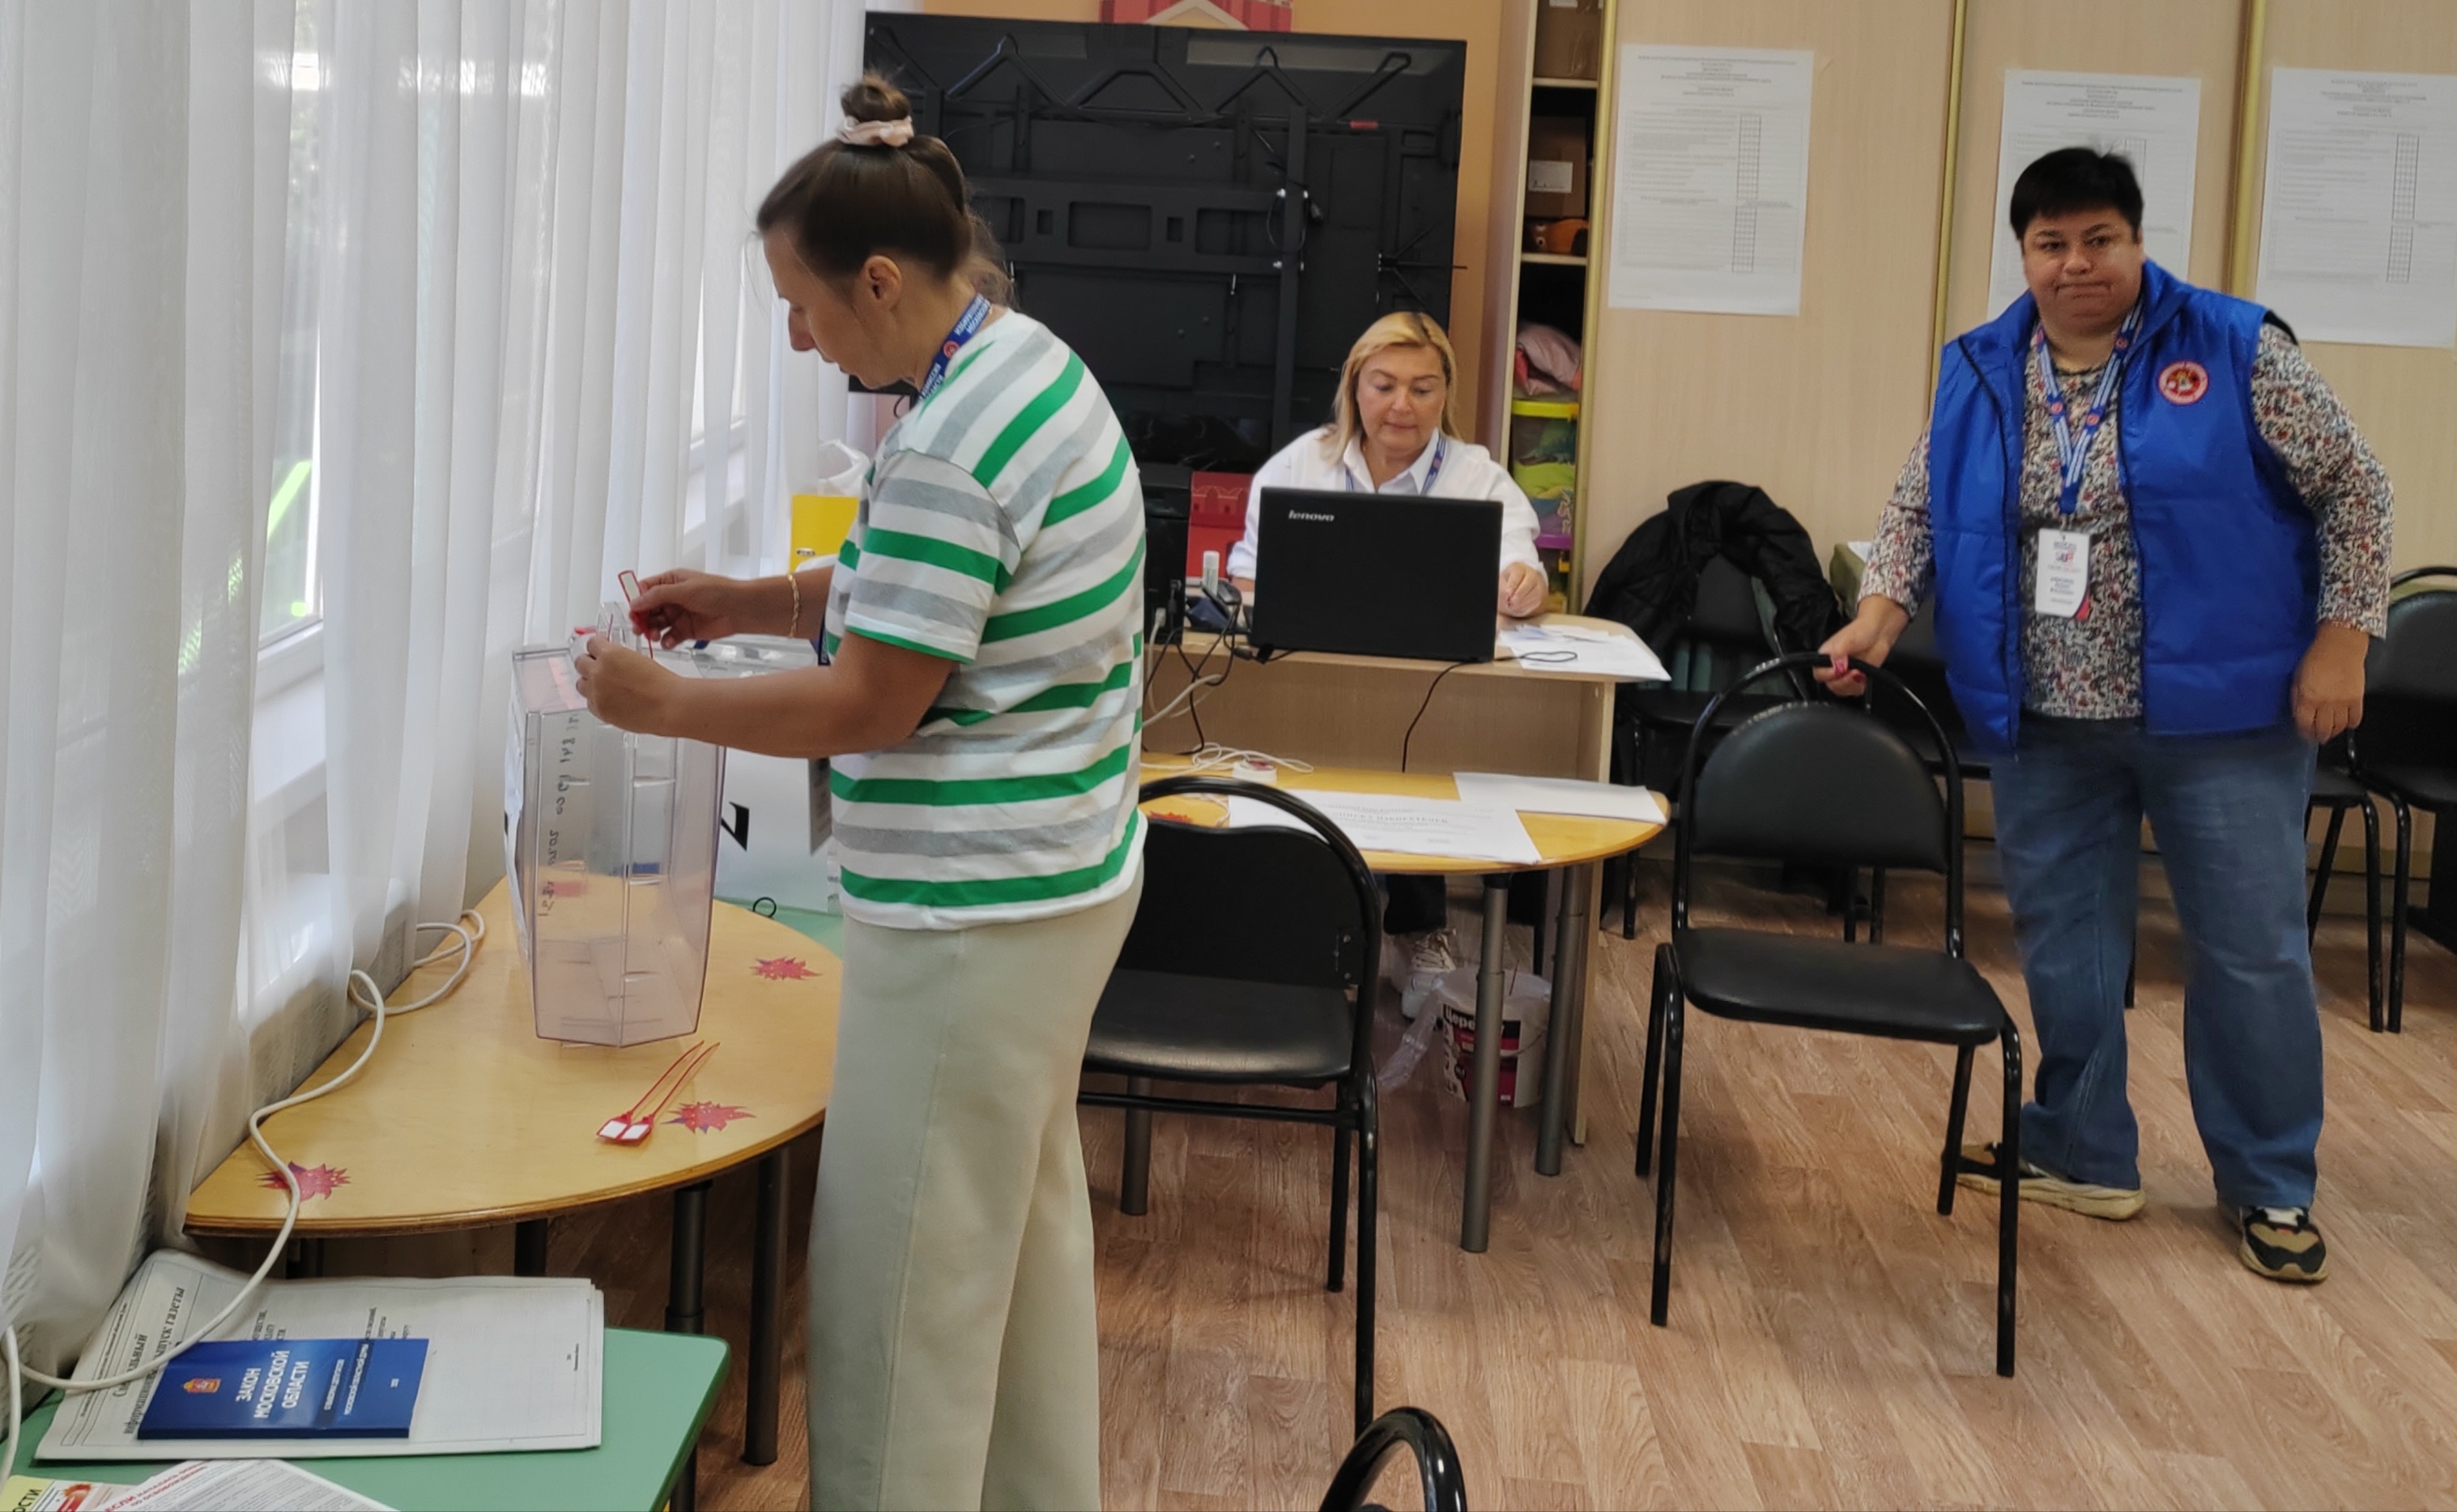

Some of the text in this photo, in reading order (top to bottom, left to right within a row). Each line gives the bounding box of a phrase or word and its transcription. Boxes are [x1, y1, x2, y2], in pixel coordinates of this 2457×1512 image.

[1288, 509, 1335, 522] lenovo
[153, 1327, 173, 1361] ыпуск
[165, 1287, 185, 1326] газеты
[236, 1367, 262, 1402] ЗАКОН
[253, 1350, 290, 1418] МОСКОВСКОЙ
[282, 1361, 310, 1408] ОБЛАСТИ
